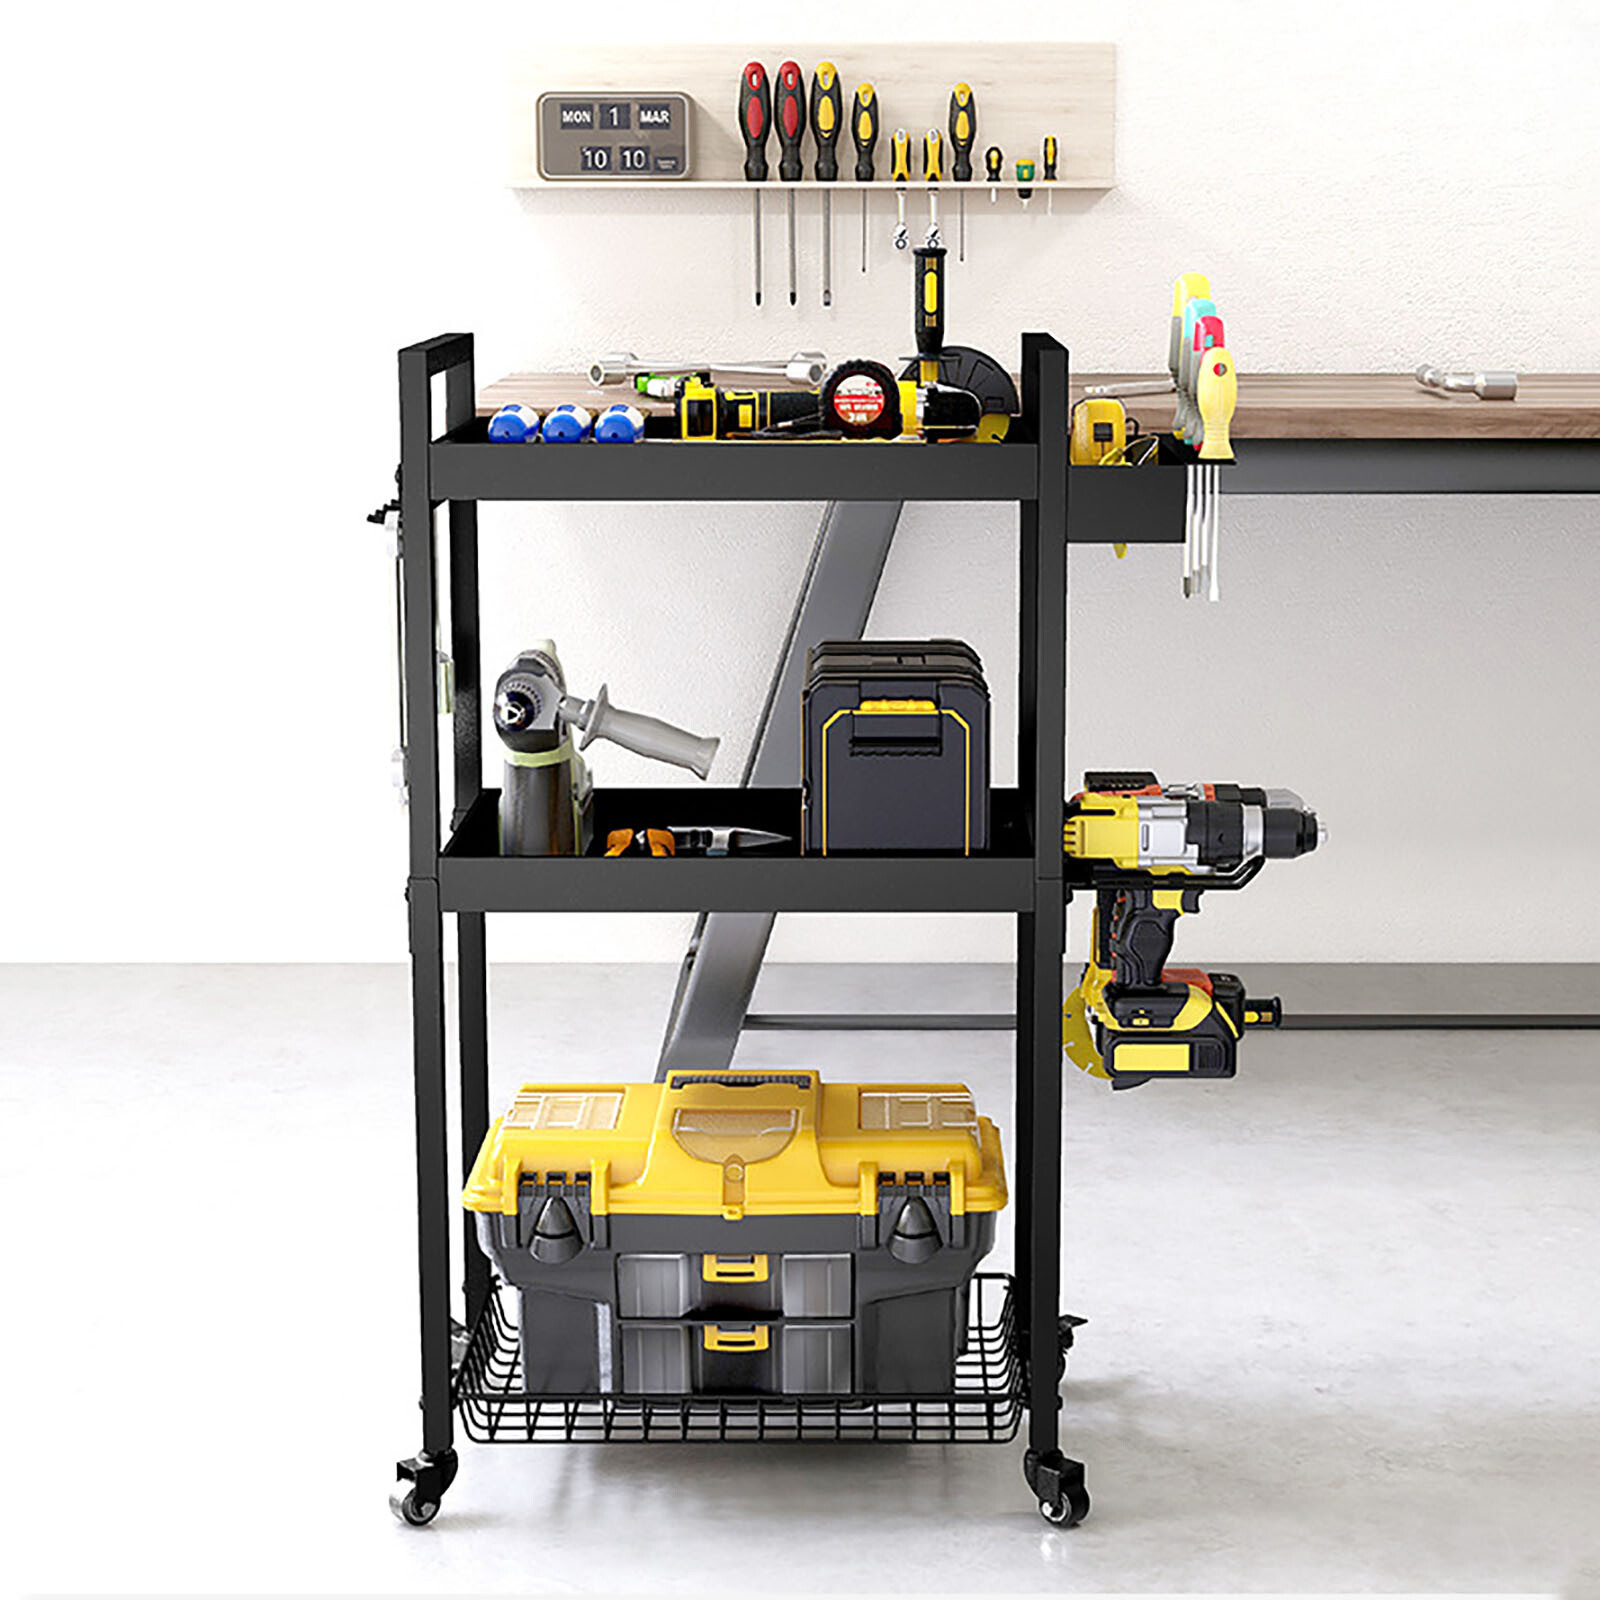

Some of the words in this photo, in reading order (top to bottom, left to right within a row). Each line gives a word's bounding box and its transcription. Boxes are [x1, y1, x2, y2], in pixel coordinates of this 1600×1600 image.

[562, 110, 592, 123] MON
[608, 106, 619, 126] 1
[639, 110, 670, 123] MAR
[586, 149, 608, 169] 10
[622, 149, 646, 169] 10
